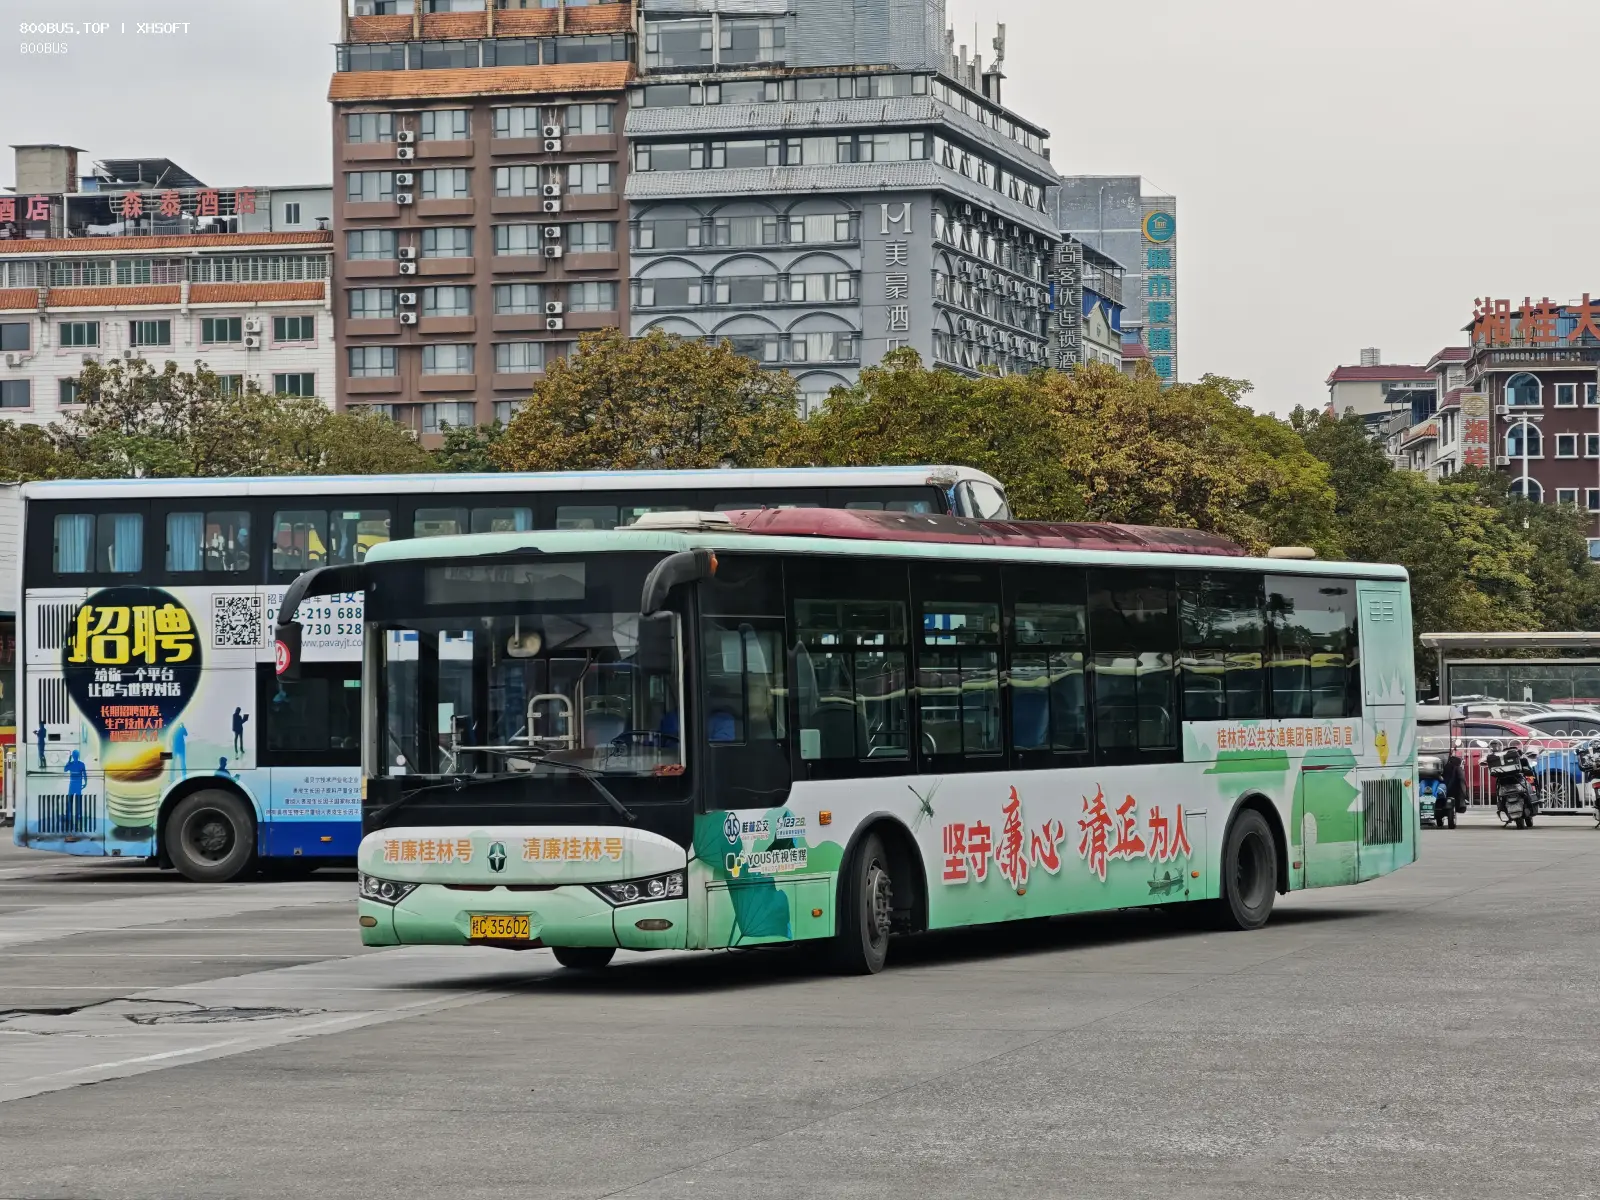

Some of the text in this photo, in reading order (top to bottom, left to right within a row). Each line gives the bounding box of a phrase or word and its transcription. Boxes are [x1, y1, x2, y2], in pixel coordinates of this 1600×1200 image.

[121, 188, 257, 218] 森泰酒店
[1058, 244, 1077, 378] 尚客优连锁酒
[1146, 247, 1172, 390] 城市便捷酒
[1473, 293, 1600, 344] 湘桂大
[1463, 418, 1489, 469] 湘桂
[267, 607, 331, 620] 03-219
[67, 603, 195, 664] 招聘
[88, 682, 181, 697] 让你与世界对话
[95, 668, 174, 682] 给你一个平台
[105, 718, 164, 729] 生产技术人才
[383, 839, 473, 863] 清廉桂林号
[522, 837, 623, 862] 清廉桂林号
[942, 782, 1192, 891] 坚守廉心 清正为人
